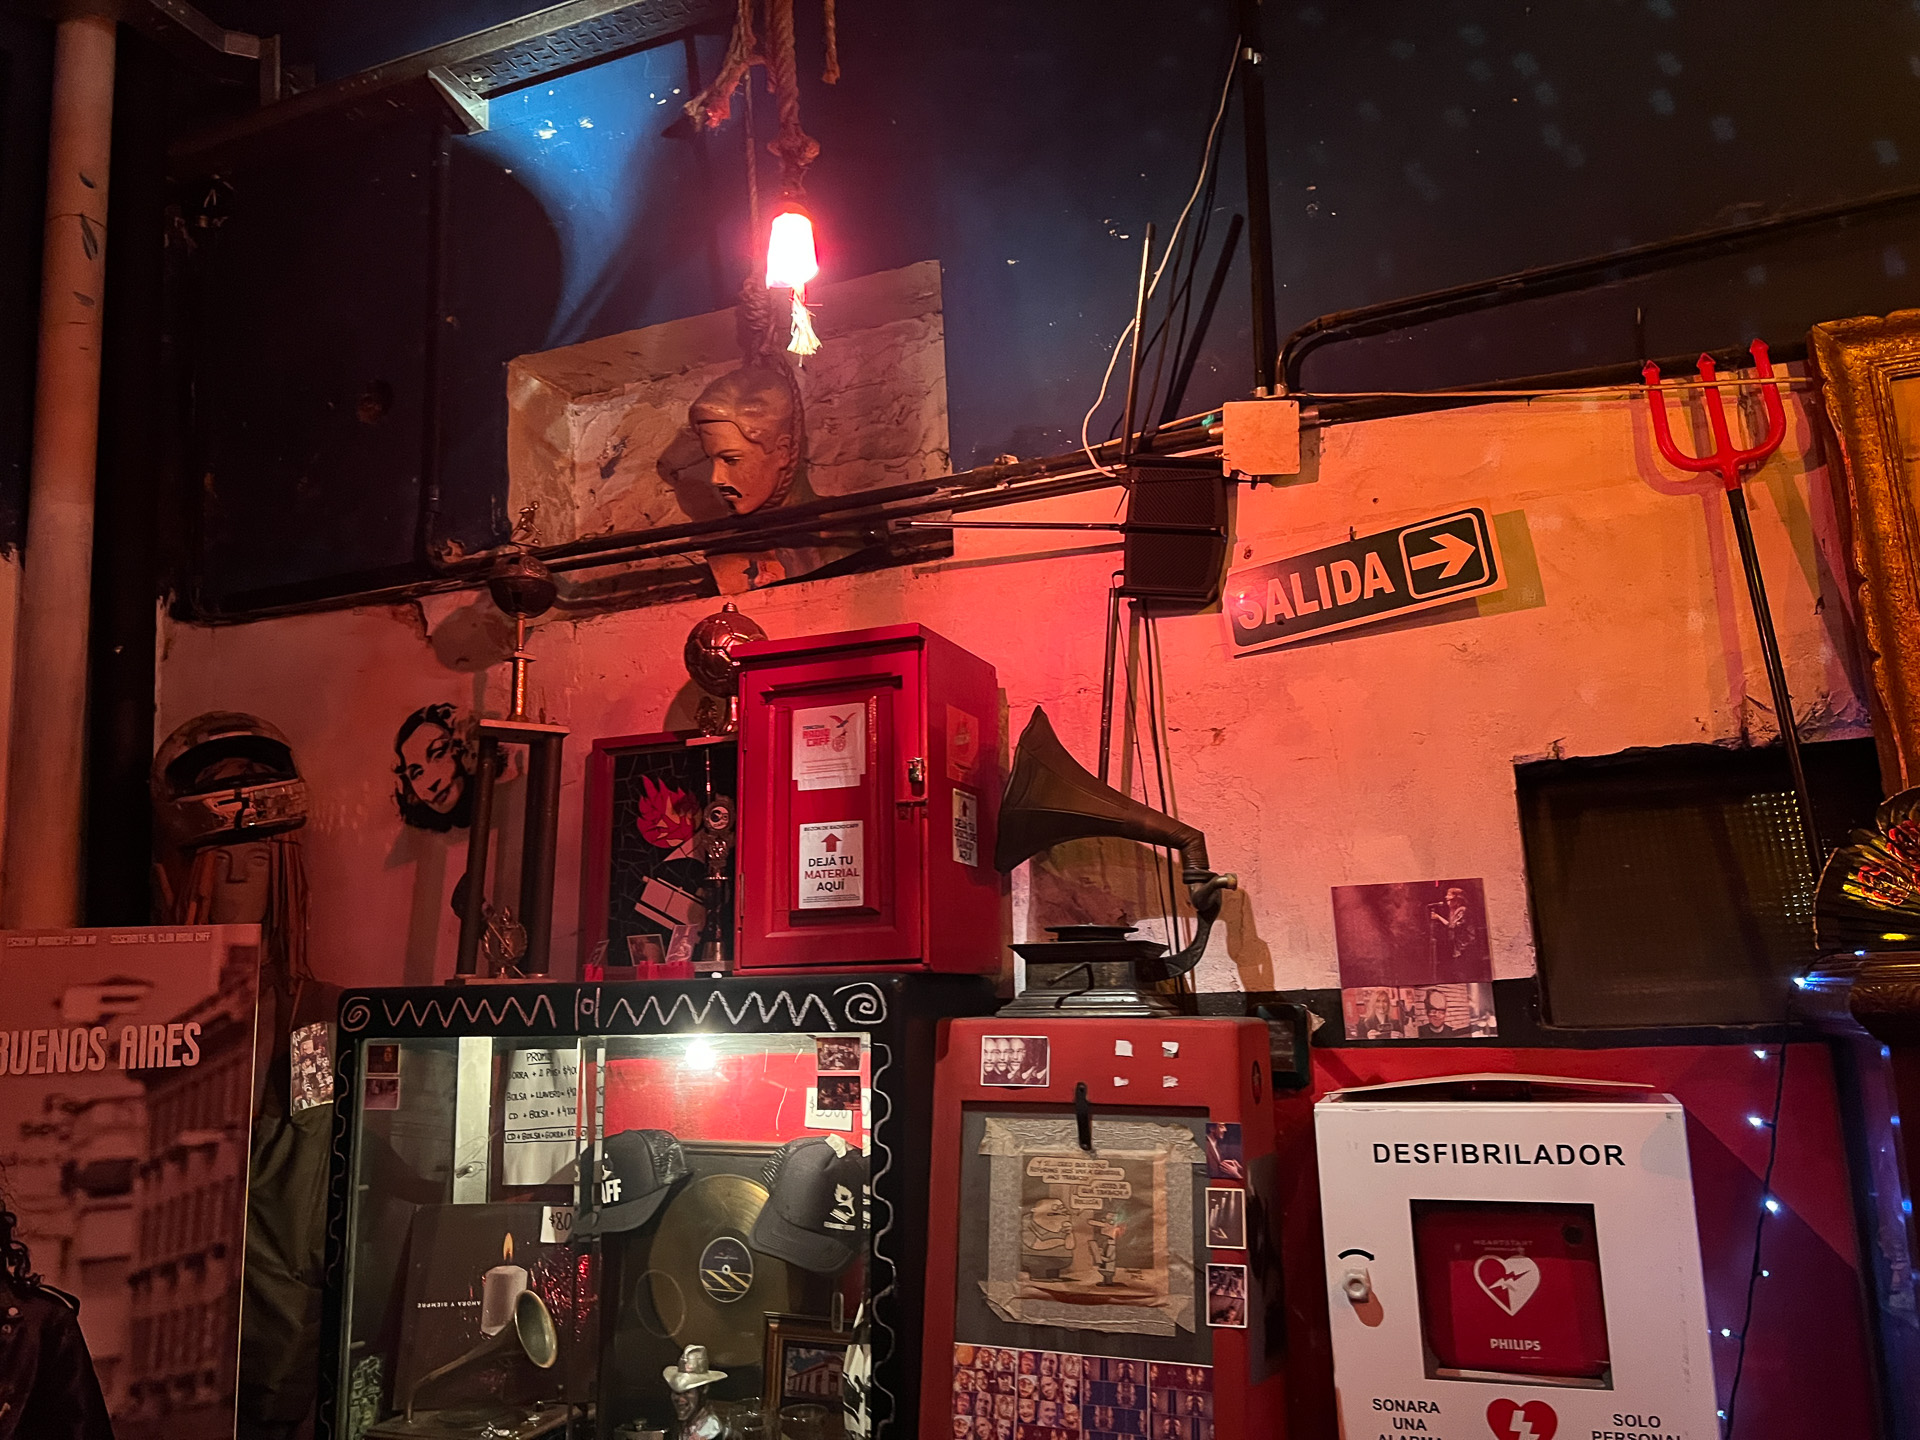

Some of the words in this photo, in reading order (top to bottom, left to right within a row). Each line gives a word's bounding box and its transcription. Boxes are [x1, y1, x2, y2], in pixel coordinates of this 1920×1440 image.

[1236, 551, 1396, 630] SALIDA
[809, 855, 837, 867] DEJÁ
[839, 856, 854, 865] TU
[804, 868, 860, 879] MATERIAL
[816, 878, 845, 893] AQUÍ
[119, 1022, 202, 1070] AIRES
[1373, 1143, 1626, 1166] DESFIBRILADOR
[1490, 1338, 1542, 1351] PHILIPS
[1372, 1398, 1441, 1414] SONARA
[1392, 1416, 1428, 1432] UNA
[1613, 1413, 1662, 1428] SOLO
